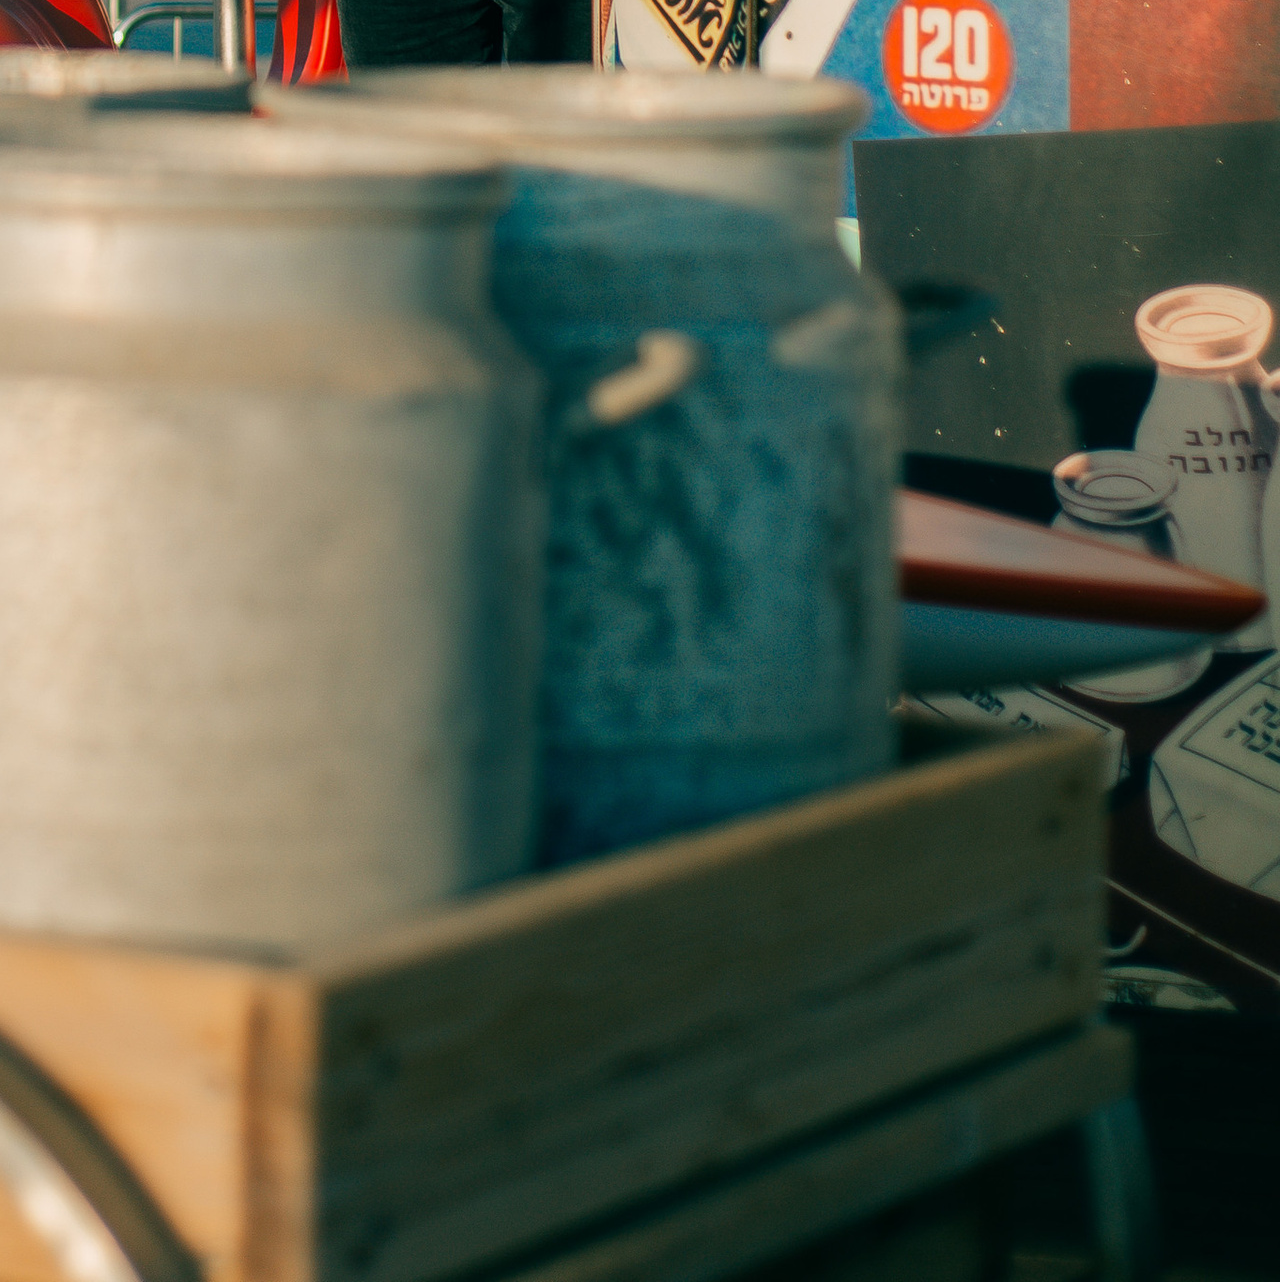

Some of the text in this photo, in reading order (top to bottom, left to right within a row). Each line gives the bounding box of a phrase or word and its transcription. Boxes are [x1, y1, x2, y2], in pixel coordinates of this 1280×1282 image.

[902, 5, 989, 83] 120
[901, 82, 990, 112] פרוטה
[1184, 426, 1251, 447] חלב
[1167, 453, 1272, 475] תנובה
